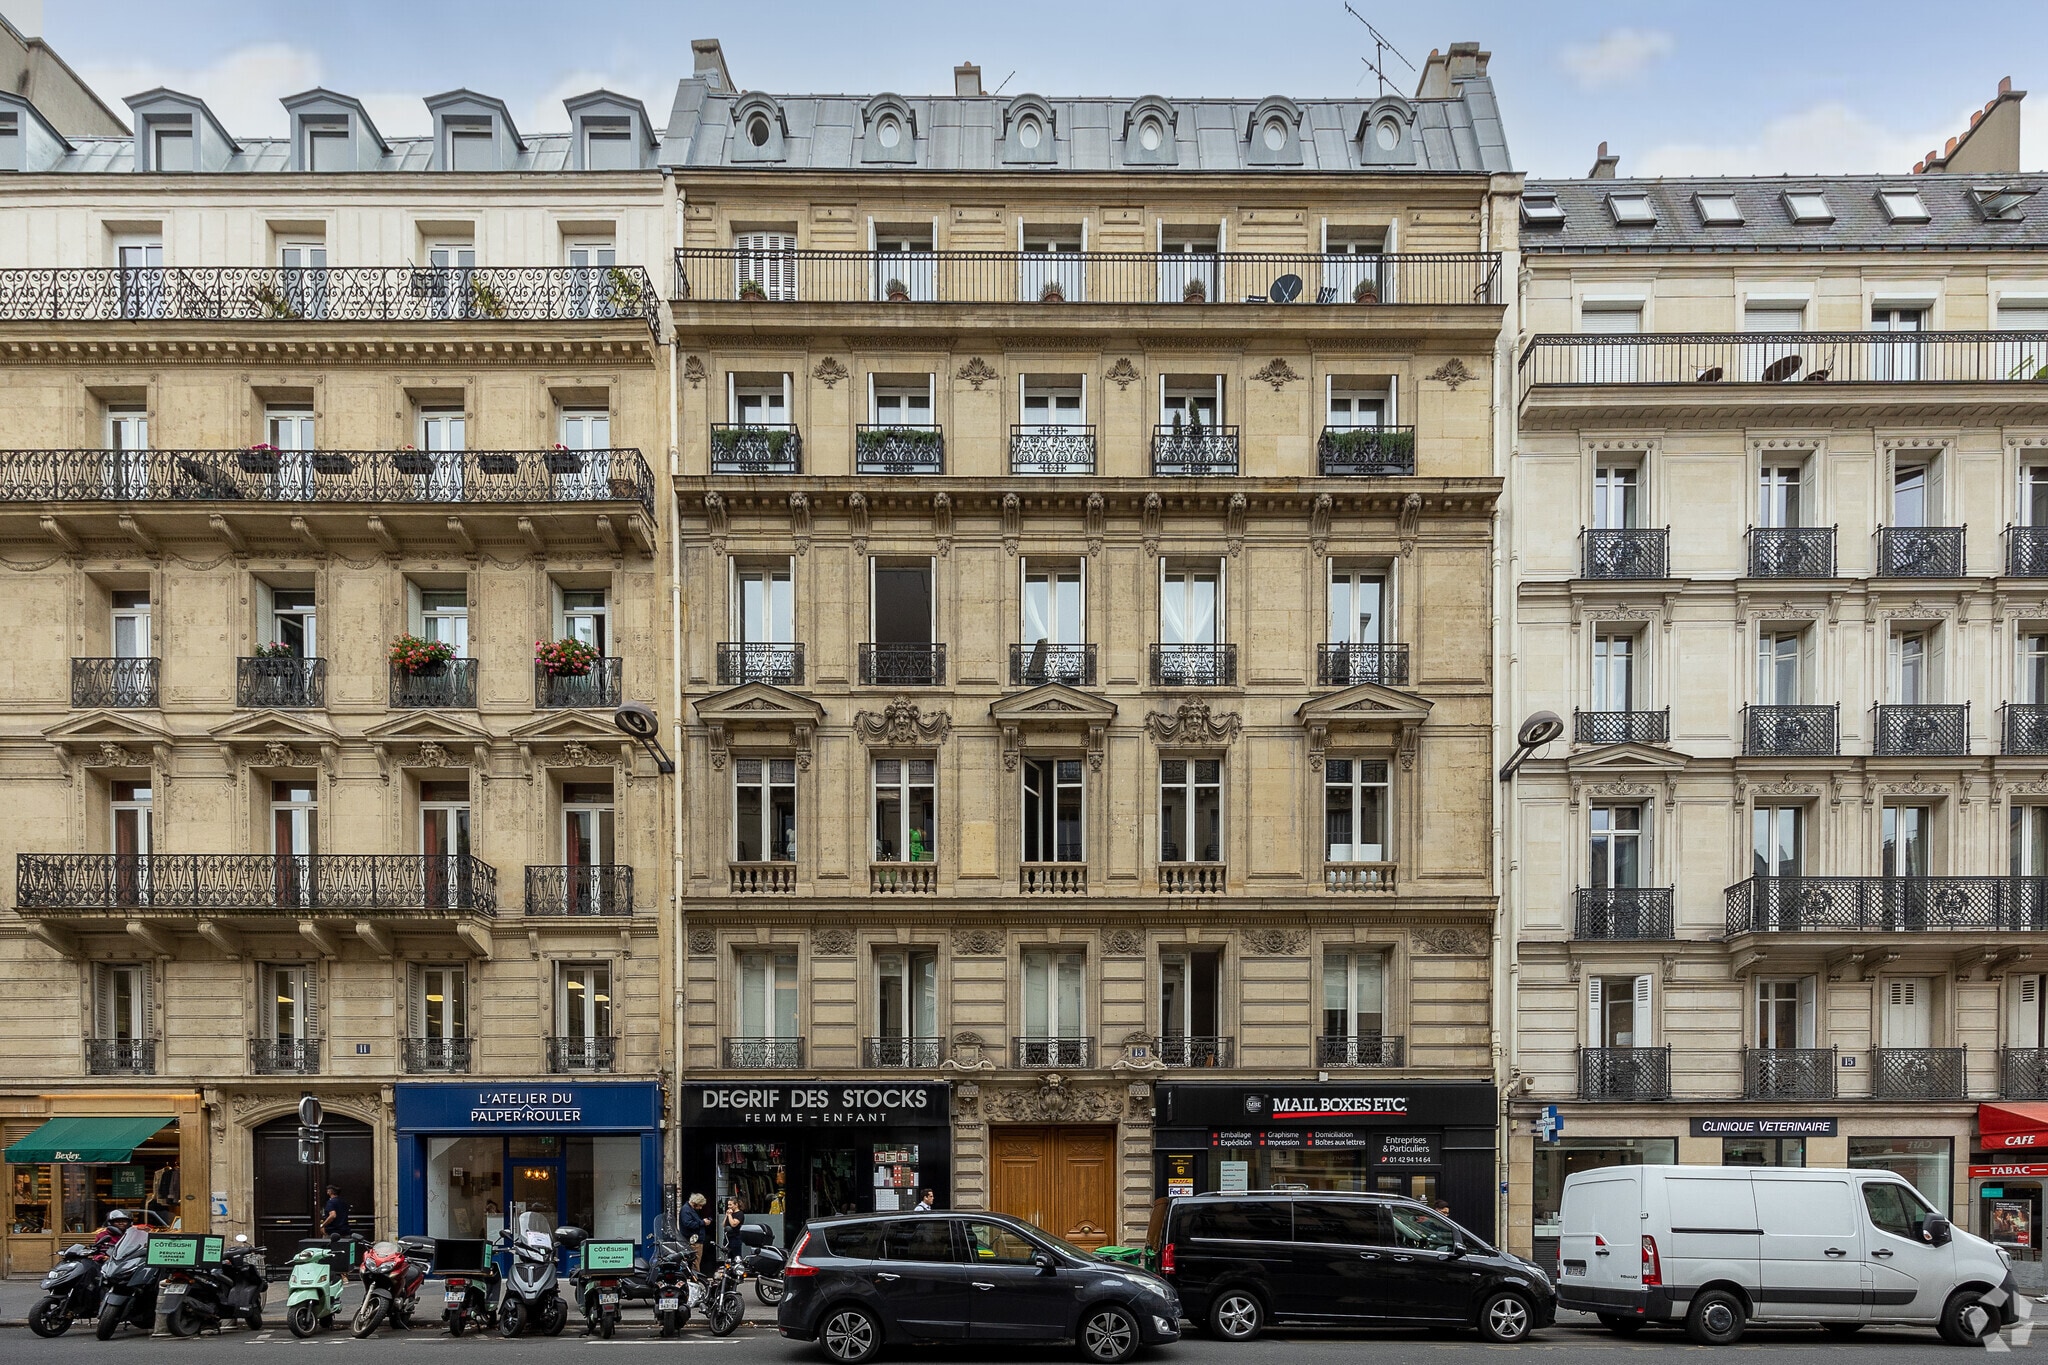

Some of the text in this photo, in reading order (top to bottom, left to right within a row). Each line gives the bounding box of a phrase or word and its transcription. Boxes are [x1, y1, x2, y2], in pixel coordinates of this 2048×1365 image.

[1134, 1047, 1144, 1057] 13
[1844, 1057, 1854, 1066] 15
[479, 1093, 572, 1104] L'ATELIER DU
[702, 1089, 927, 1108] DEGRIF DES STOCKS
[1272, 1098, 1408, 1112] MAIL BOXES ETC.
[745, 1113, 804, 1122] FEMME
[823, 1113, 887, 1122] ENFANT
[1702, 1120, 1831, 1132] CLINIQUE VETERINAIRE
[1220, 1131, 1252, 1139] Emballage
[1267, 1131, 1300, 1139] Graphisme
[1220, 1139, 1253, 1147] Expédition
[1267, 1139, 1300, 1147] Impression
[1385, 1136, 1427, 1145] Entreprises
[2004, 1135, 2036, 1146] CAFE
[1389, 1144, 1430, 1153] Particuliers
[1990, 1166, 2031, 1175] TABAC
[1169, 1187, 1190, 1196] FedEx
